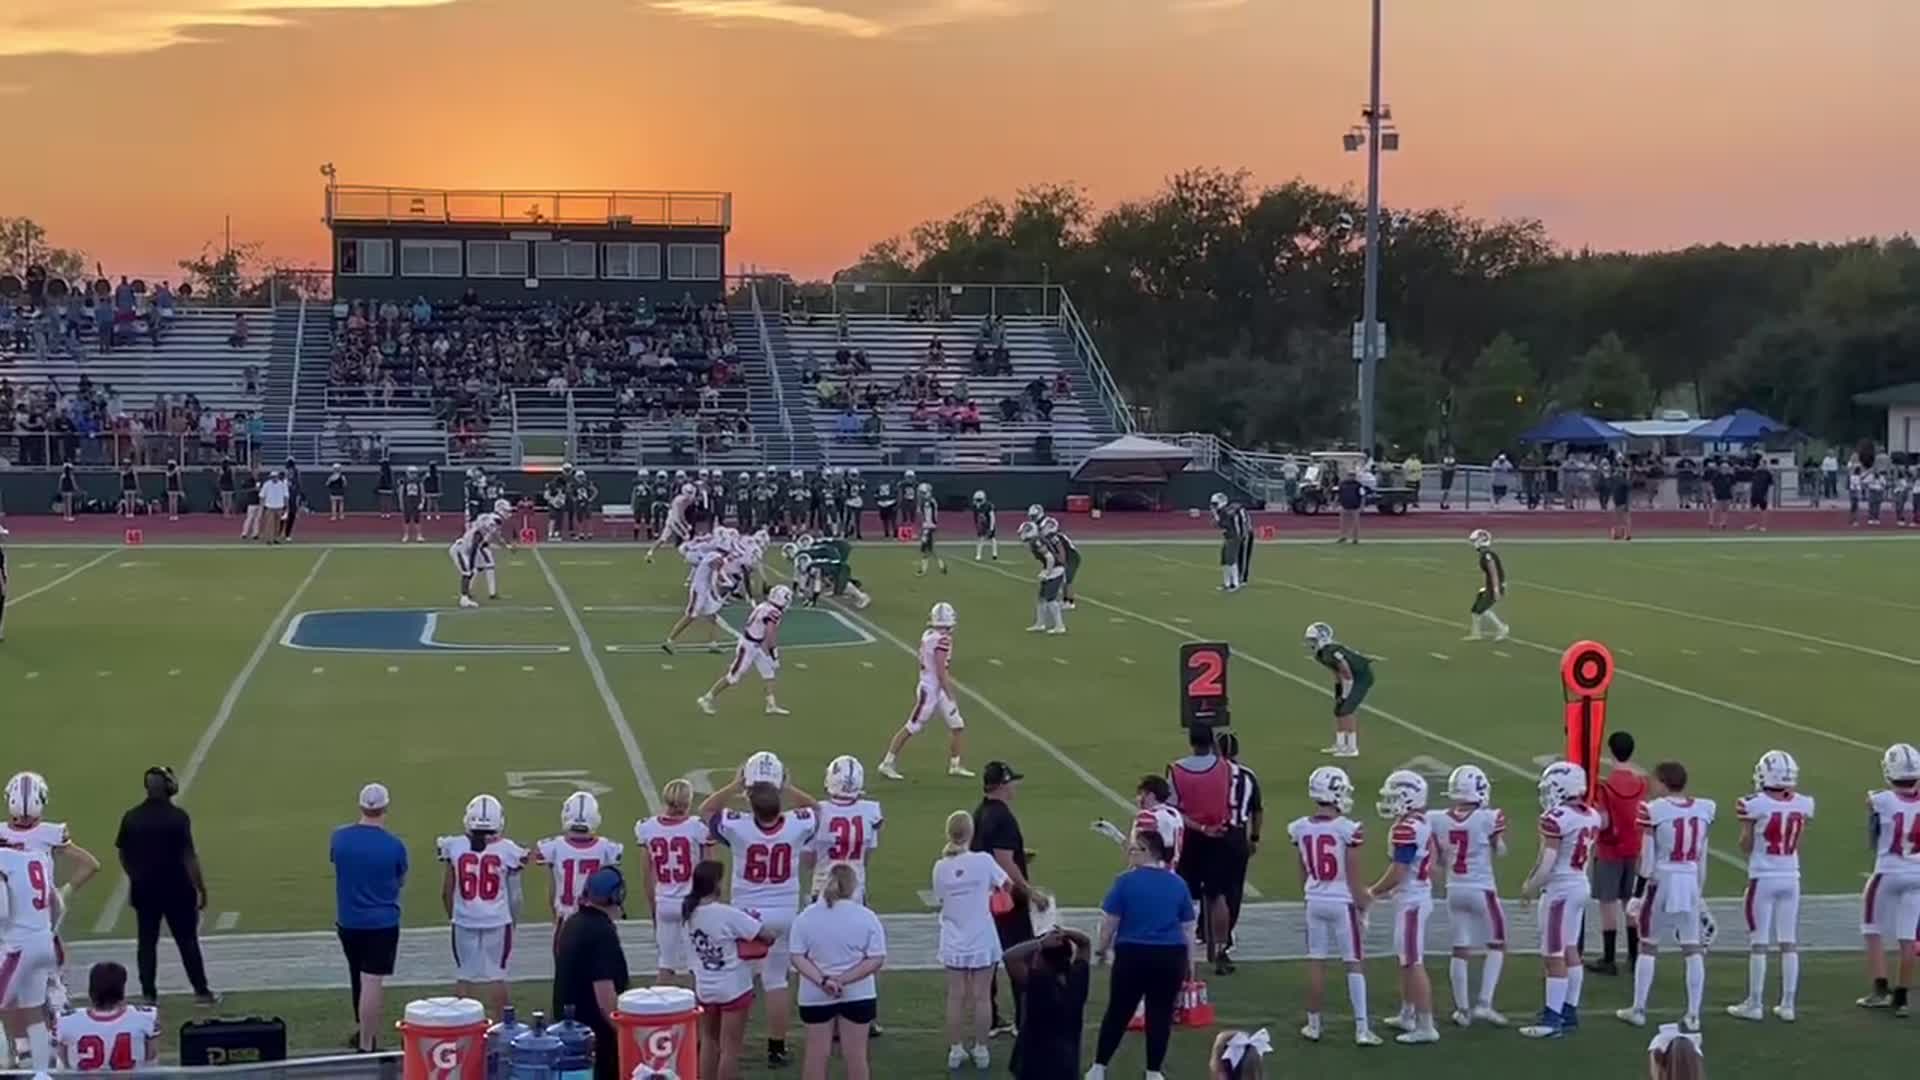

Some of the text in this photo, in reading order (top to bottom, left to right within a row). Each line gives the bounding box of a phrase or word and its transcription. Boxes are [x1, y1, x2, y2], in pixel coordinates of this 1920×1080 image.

[1188, 650, 1223, 696] 2
[829, 816, 863, 860] 31
[1449, 830, 1468, 874] 7
[1670, 816, 1699, 862] 11
[1763, 811, 1802, 855] 40
[458, 853, 502, 900] 66
[651, 837, 692, 883] 23
[743, 843, 793, 884] 60
[1303, 834, 1338, 881] 16
[28, 860, 47, 911] 9
[77, 1031, 135, 1070] 24
[432, 1043, 457, 1069] G
[648, 1031, 673, 1057] G
